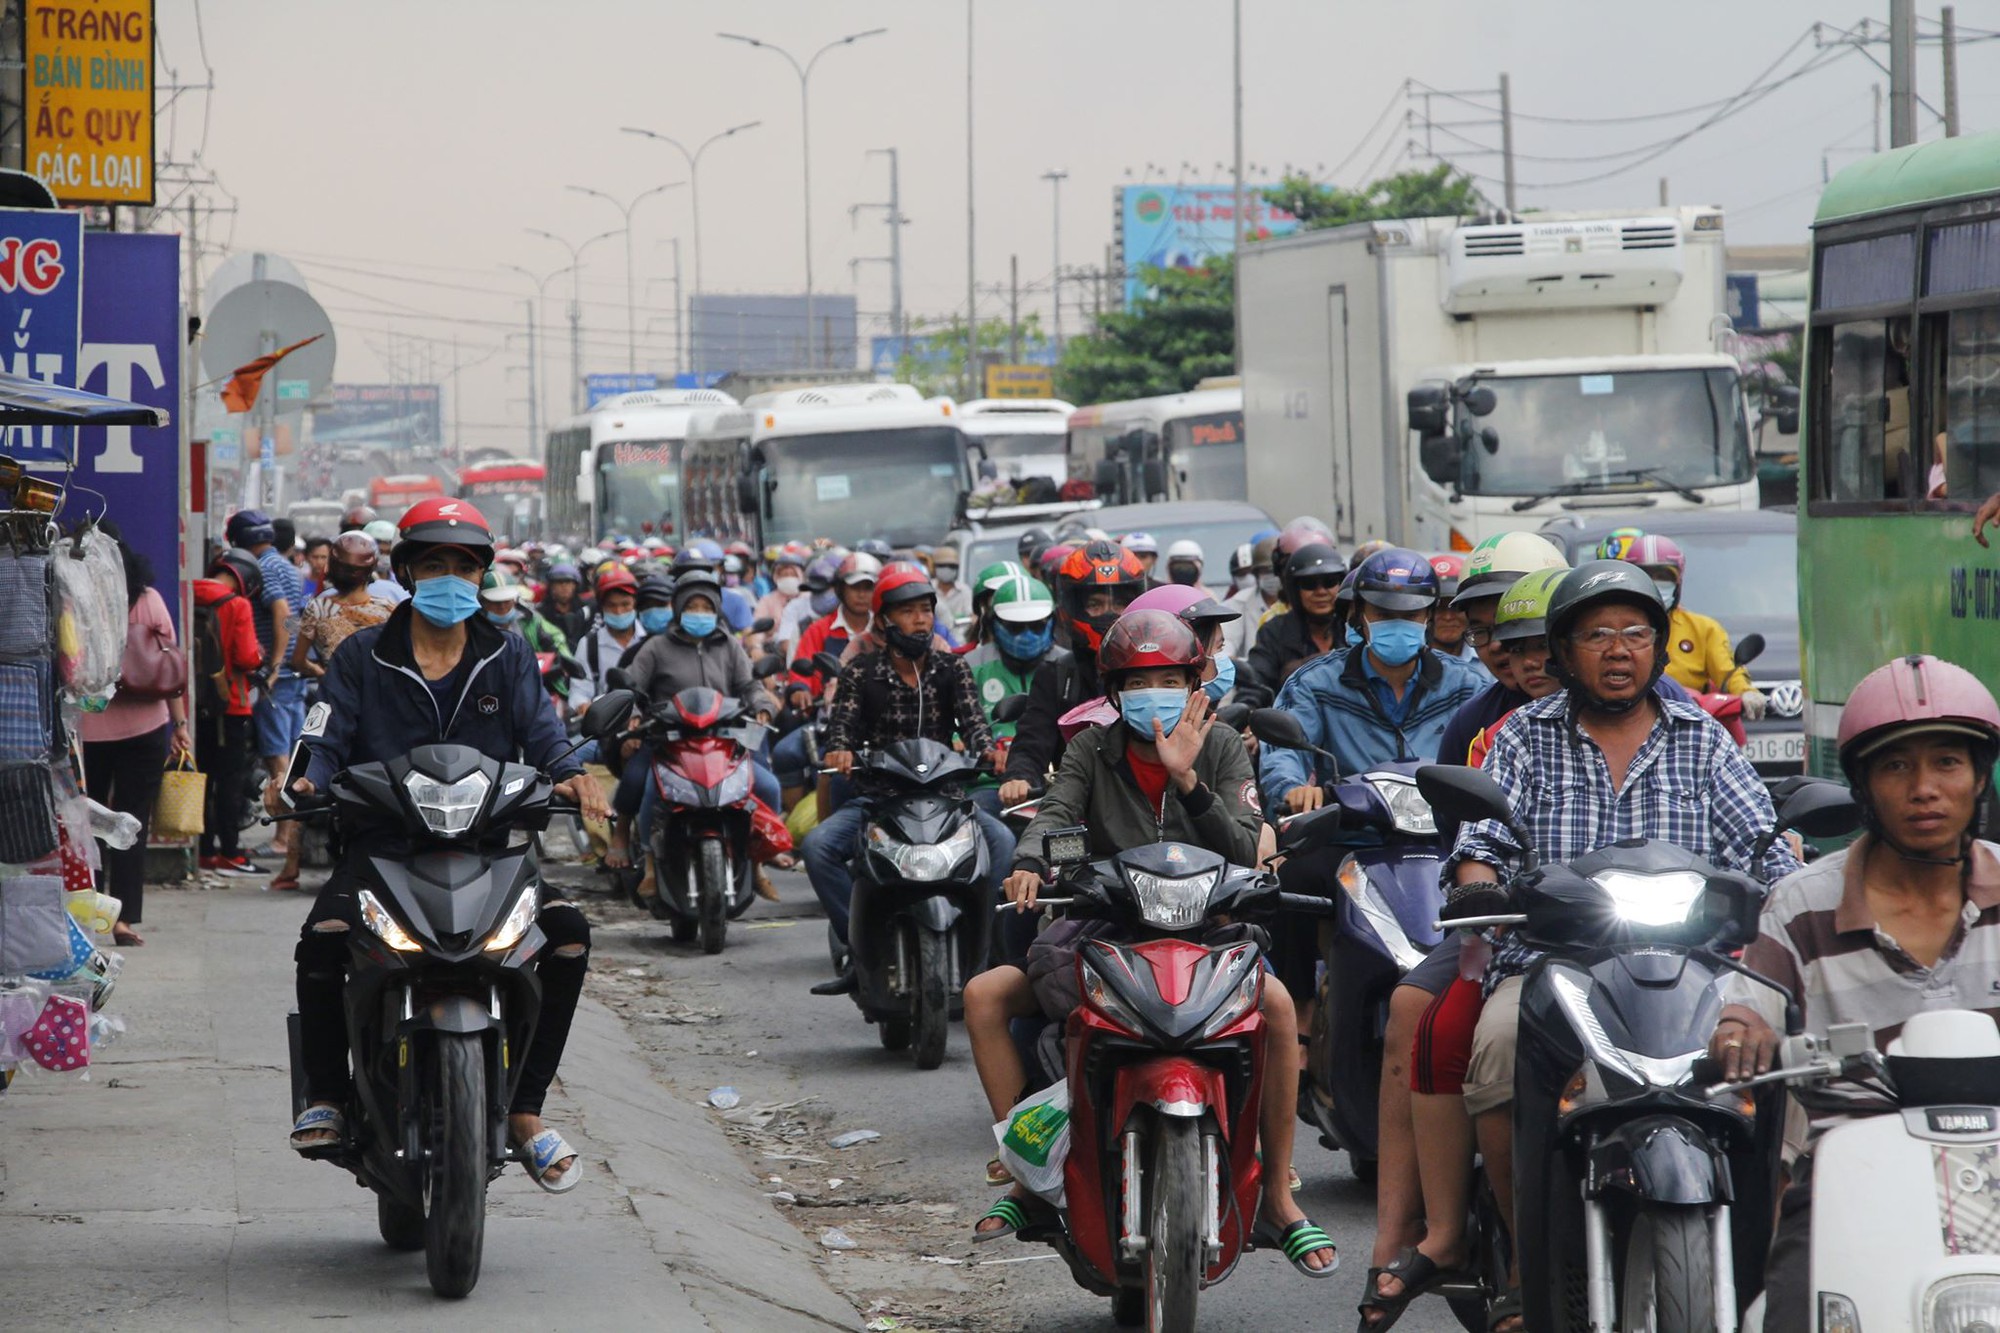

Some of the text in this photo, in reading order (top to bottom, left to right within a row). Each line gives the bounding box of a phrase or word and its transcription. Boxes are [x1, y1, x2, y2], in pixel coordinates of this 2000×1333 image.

[36, 6, 143, 43] TRANG
[34, 46, 144, 92] BÁN BÌNH
[35, 91, 141, 147] ẮC QUY
[36, 143, 142, 196] CÁC LOẠI
[1533, 226, 1583, 236] THERM
[1936, 1115, 1989, 1130] YAMAHA
